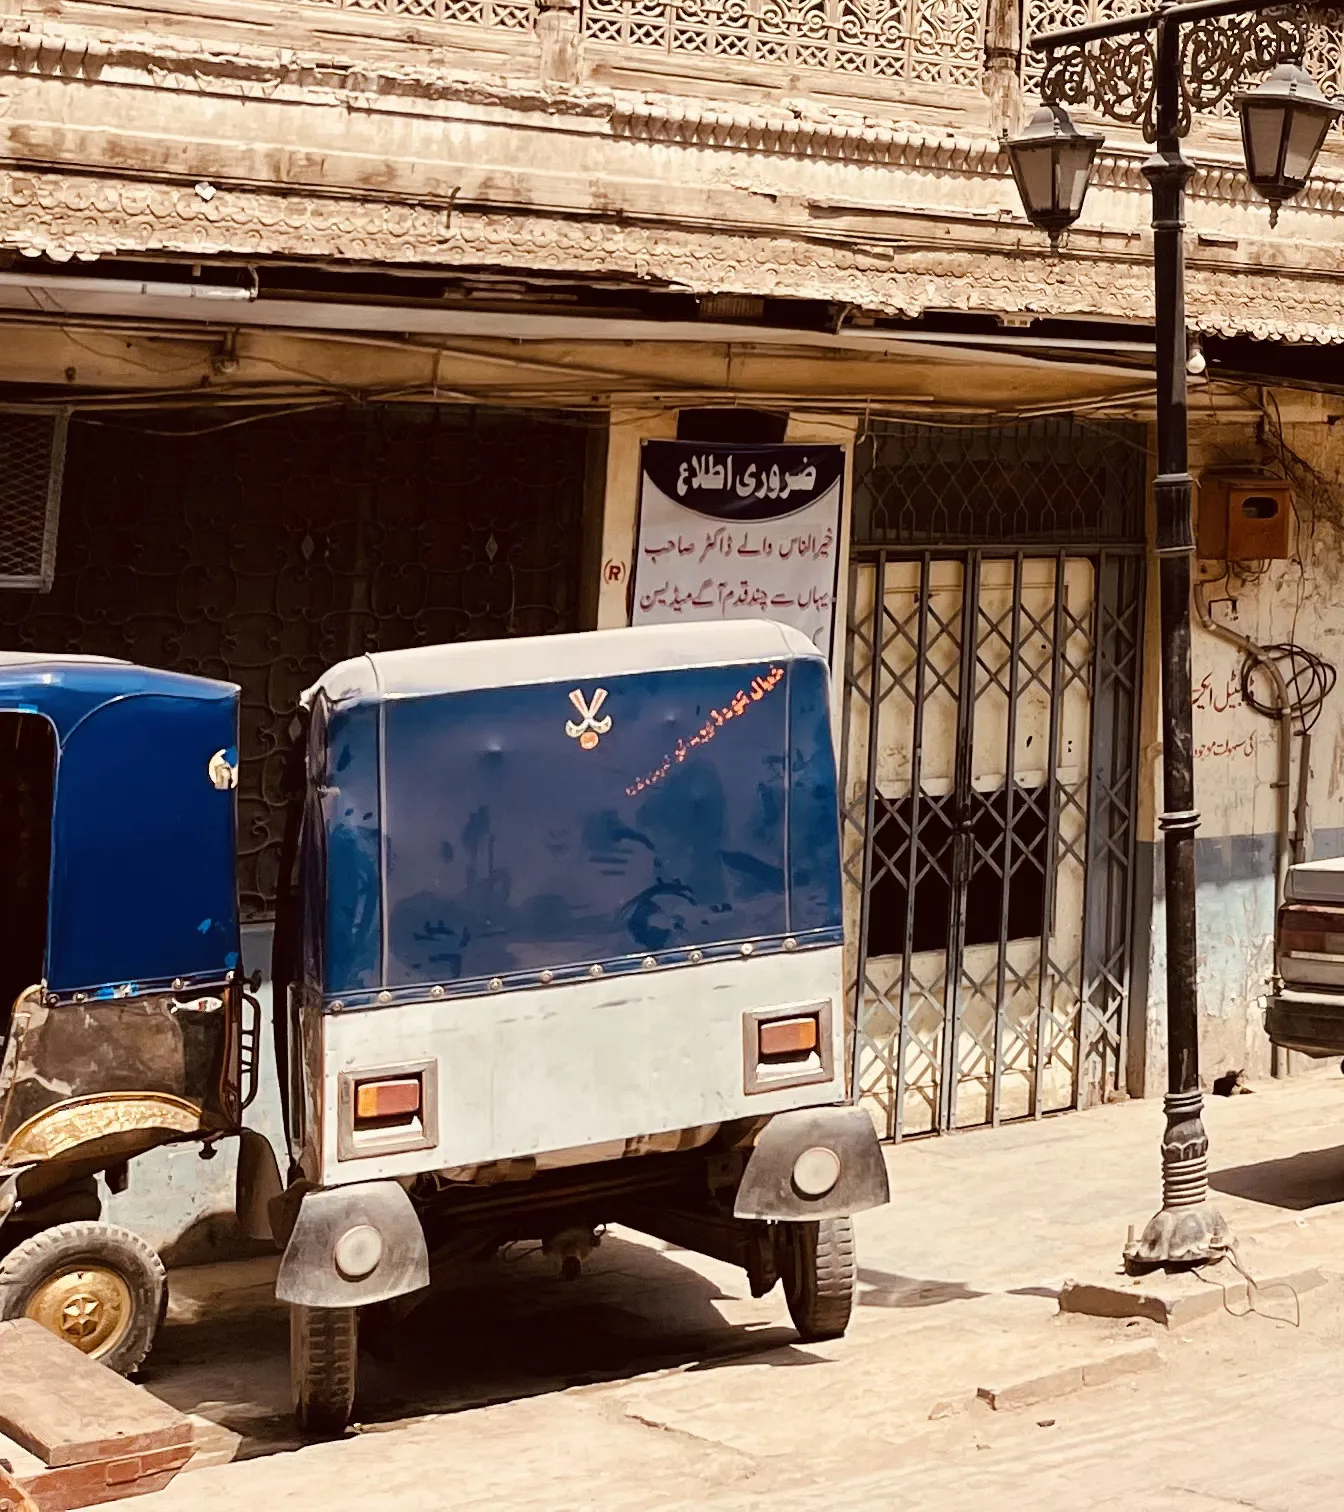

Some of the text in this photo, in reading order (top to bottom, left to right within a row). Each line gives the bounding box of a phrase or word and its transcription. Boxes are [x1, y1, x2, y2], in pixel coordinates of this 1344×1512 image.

[676, 454, 817, 500] ضروری اطلاع
[644, 535, 695, 565] صاحب
[699, 526, 733, 563] ڈاکٹر
[736, 532, 773, 558] والے
[770, 592, 794, 609] سے
[797, 586, 829, 612] یہاں
[1213, 738, 1247, 759] سہولت
[1243, 729, 1257, 758] کی
